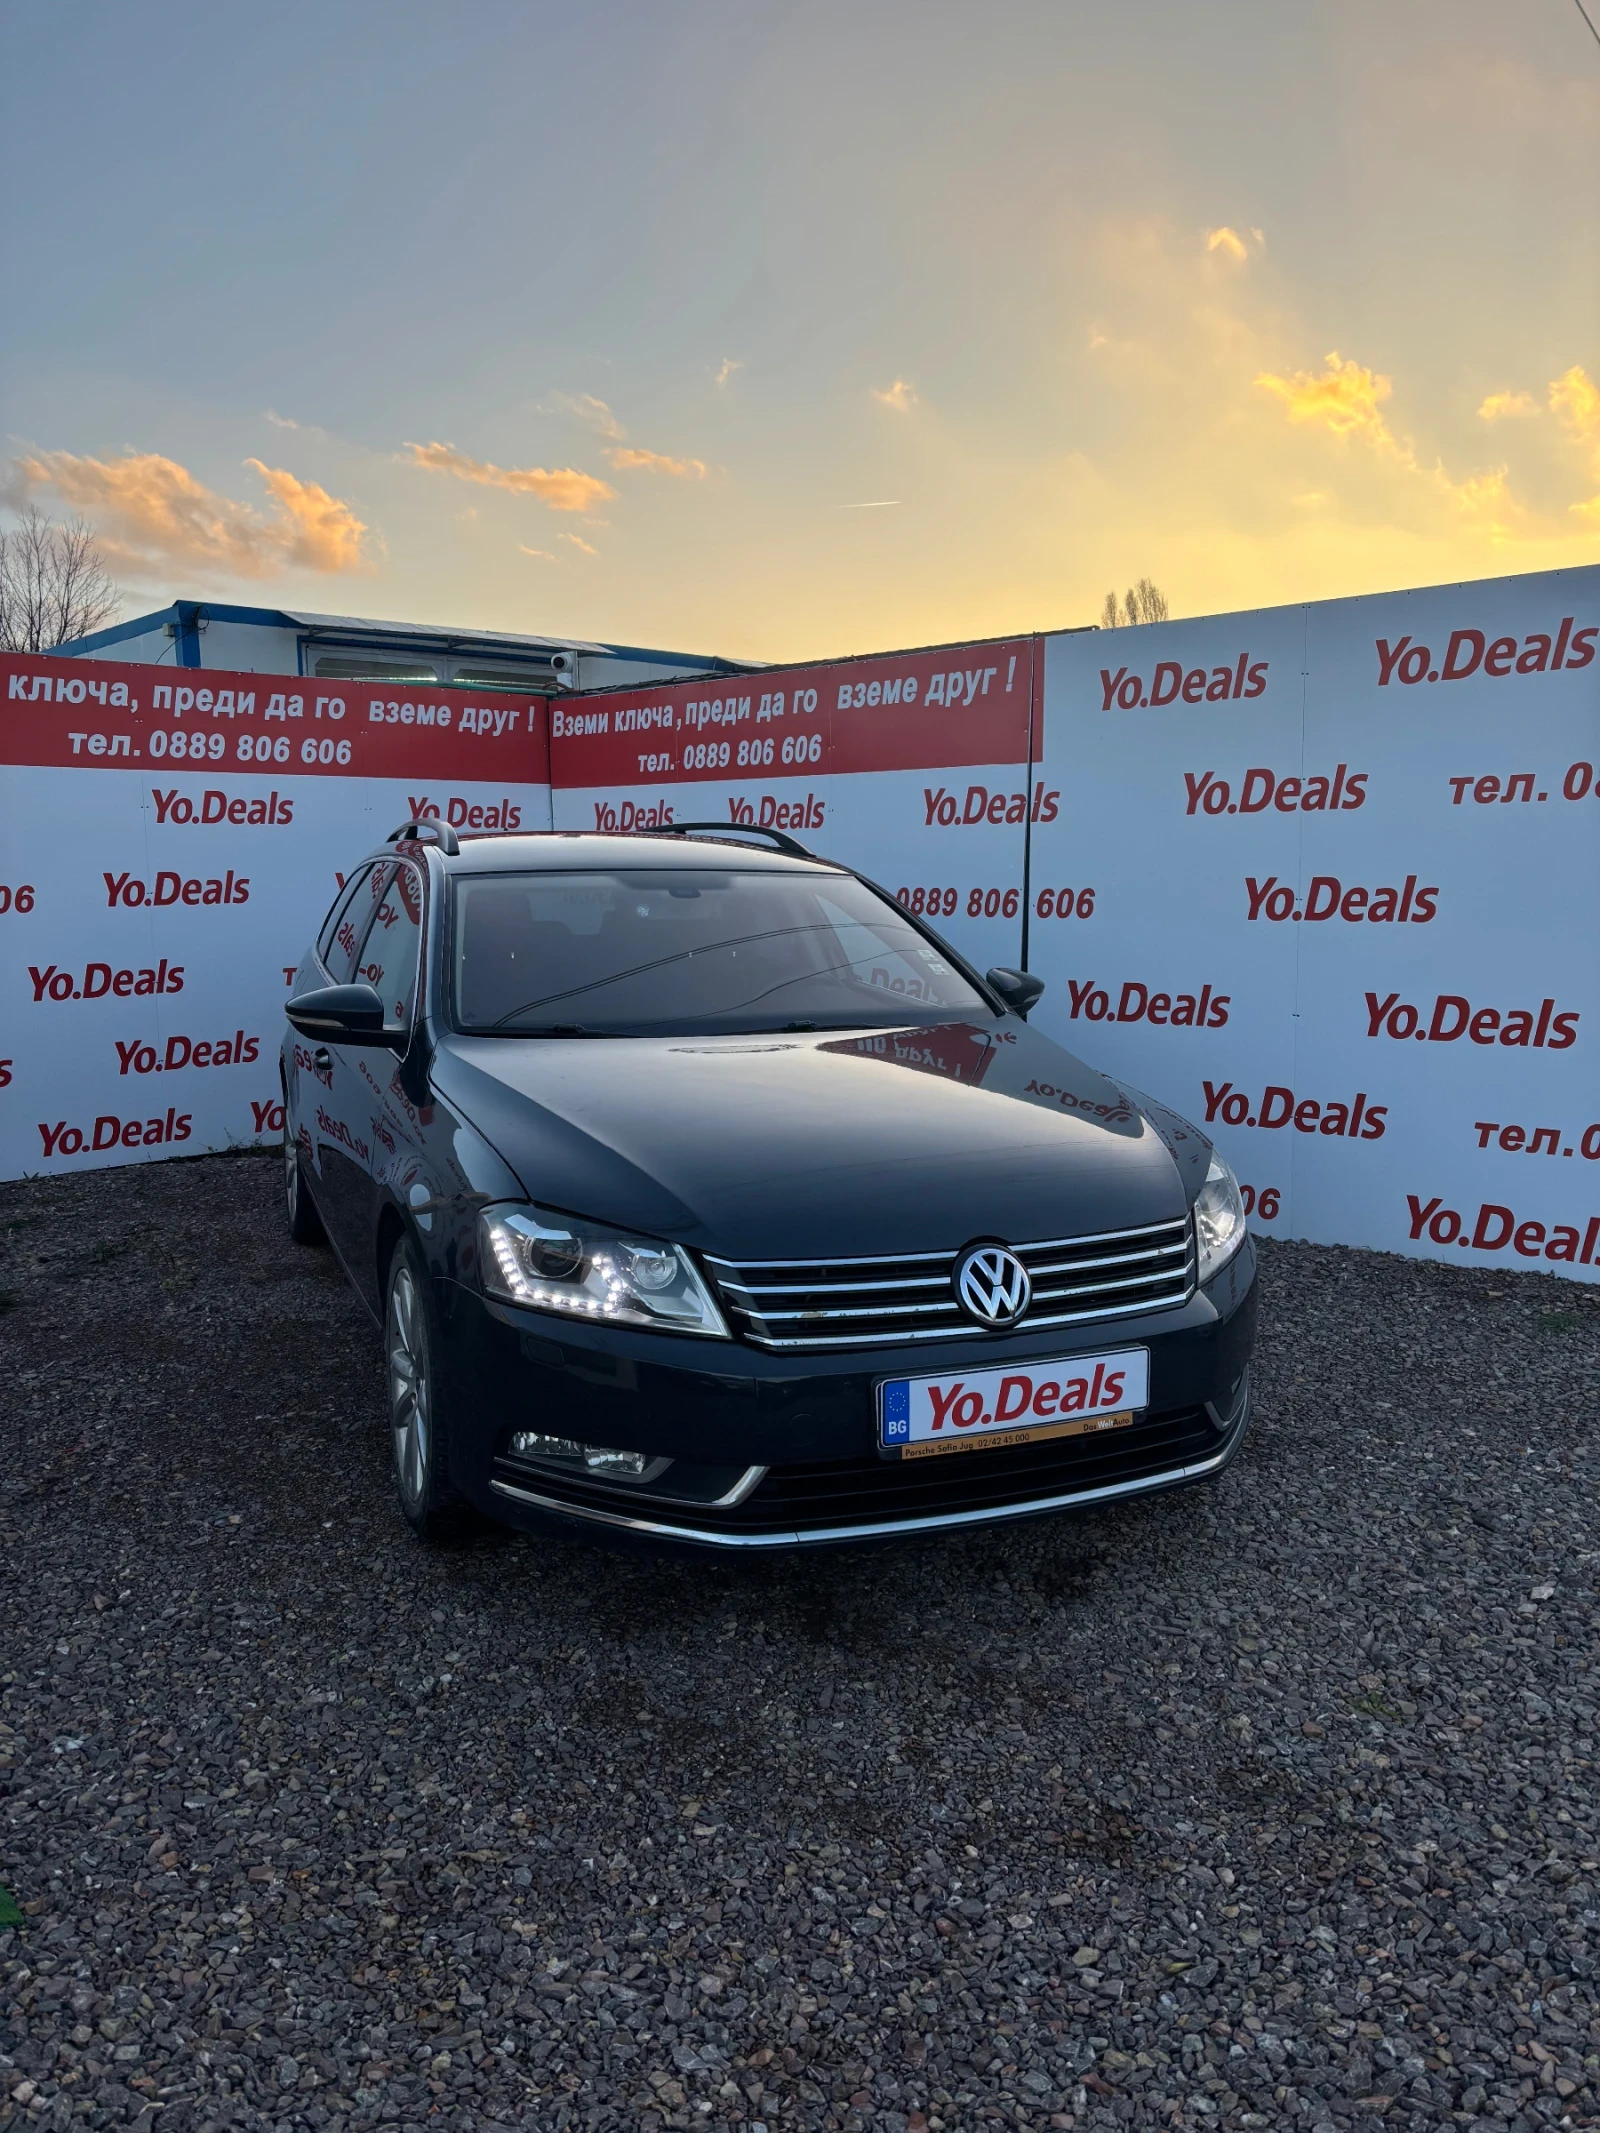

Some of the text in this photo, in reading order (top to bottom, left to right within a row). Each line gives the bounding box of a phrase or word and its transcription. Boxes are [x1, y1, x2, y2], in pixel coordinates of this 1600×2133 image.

[1376, 617, 1598, 686] Yo.Deals
[552, 711, 609, 737] Вземи
[756, 691, 785, 723] да
[793, 688, 818, 714] го
[837, 676, 918, 710] вземе
[924, 667, 997, 708] друг
[1101, 653, 1268, 711] Yo.Deals
[9, 675, 138, 713] ключа,
[153, 685, 256, 718] преди
[265, 693, 304, 721] да
[315, 697, 346, 720] го
[369, 700, 451, 726] вземе
[458, 707, 520, 737] друг
[68, 730, 352, 765] тел. 0889 806 606
[638, 733, 822, 772] тел. 0889 806 606
[924, 782, 1060, 826] Yo.Deals
[1184, 763, 1368, 815] Yo.Deals
[1449, 762, 1600, 805] тел. 0
[152, 789, 293, 825] Yo.Deals
[104, 870, 250, 907] Yo.Deals
[967, 888, 1019, 918] 806
[1036, 888, 1095, 919] 606
[1246, 875, 1440, 923] Yo.Deals
[27, 959, 184, 1002] Yo.Deals
[1068, 980, 1230, 1028] Yo.Deals
[1365, 992, 1580, 1049] Yo.Deals
[115, 1030, 259, 1075] Yo.Deals
[38, 1108, 192, 1157] Yo.Deals
[1202, 1081, 1388, 1139] Yo.Deals
[1475, 1122, 1573, 1157] тел.
[1406, 1195, 1600, 1267] Yo.Deal
[928, 1364, 1126, 1431] Yo.Deals
[888, 1420, 907, 1436] BG
[905, 1433, 1030, 1457] Porsche Sofia Jug 02/42 45 000
[1083, 1424, 1097, 1432] Das
